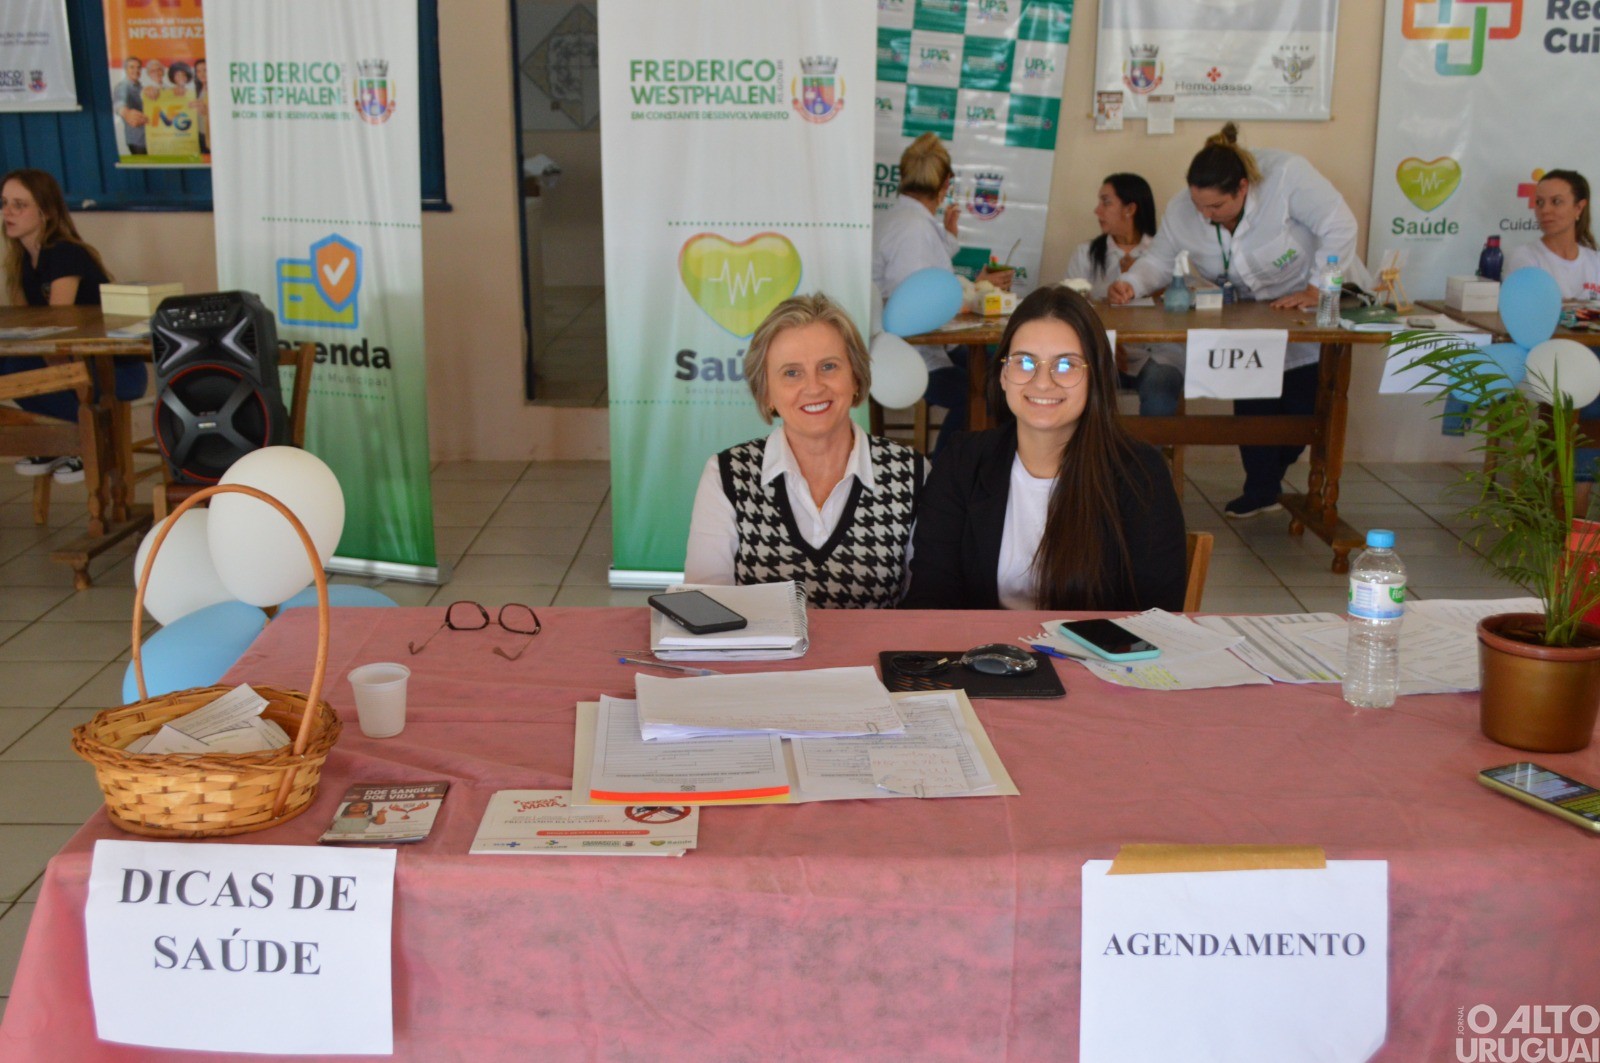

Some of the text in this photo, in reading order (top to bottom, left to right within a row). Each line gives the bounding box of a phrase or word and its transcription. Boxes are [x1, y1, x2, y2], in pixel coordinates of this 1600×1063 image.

[920, 47, 951, 62] UPA
[629, 59, 776, 82] FREDERICO
[1025, 57, 1055, 72] UPA
[230, 86, 341, 106] WESTPHALEN
[630, 85, 776, 105] WESTPHALEN
[1174, 80, 1252, 94] Hemopasso
[631, 111, 789, 120] EM CONSTANTE DESENVOLVIMENTO
[966, 106, 997, 120] UPA
[1391, 217, 1459, 235] Saúde
[1208, 348, 1263, 369] UPA
[390, 786, 435, 794] SANGUE
[120, 868, 356, 911] DICAS DE
[153, 928, 320, 975] SAÚDE
[1103, 933, 1366, 956] AGENDAMENTO
